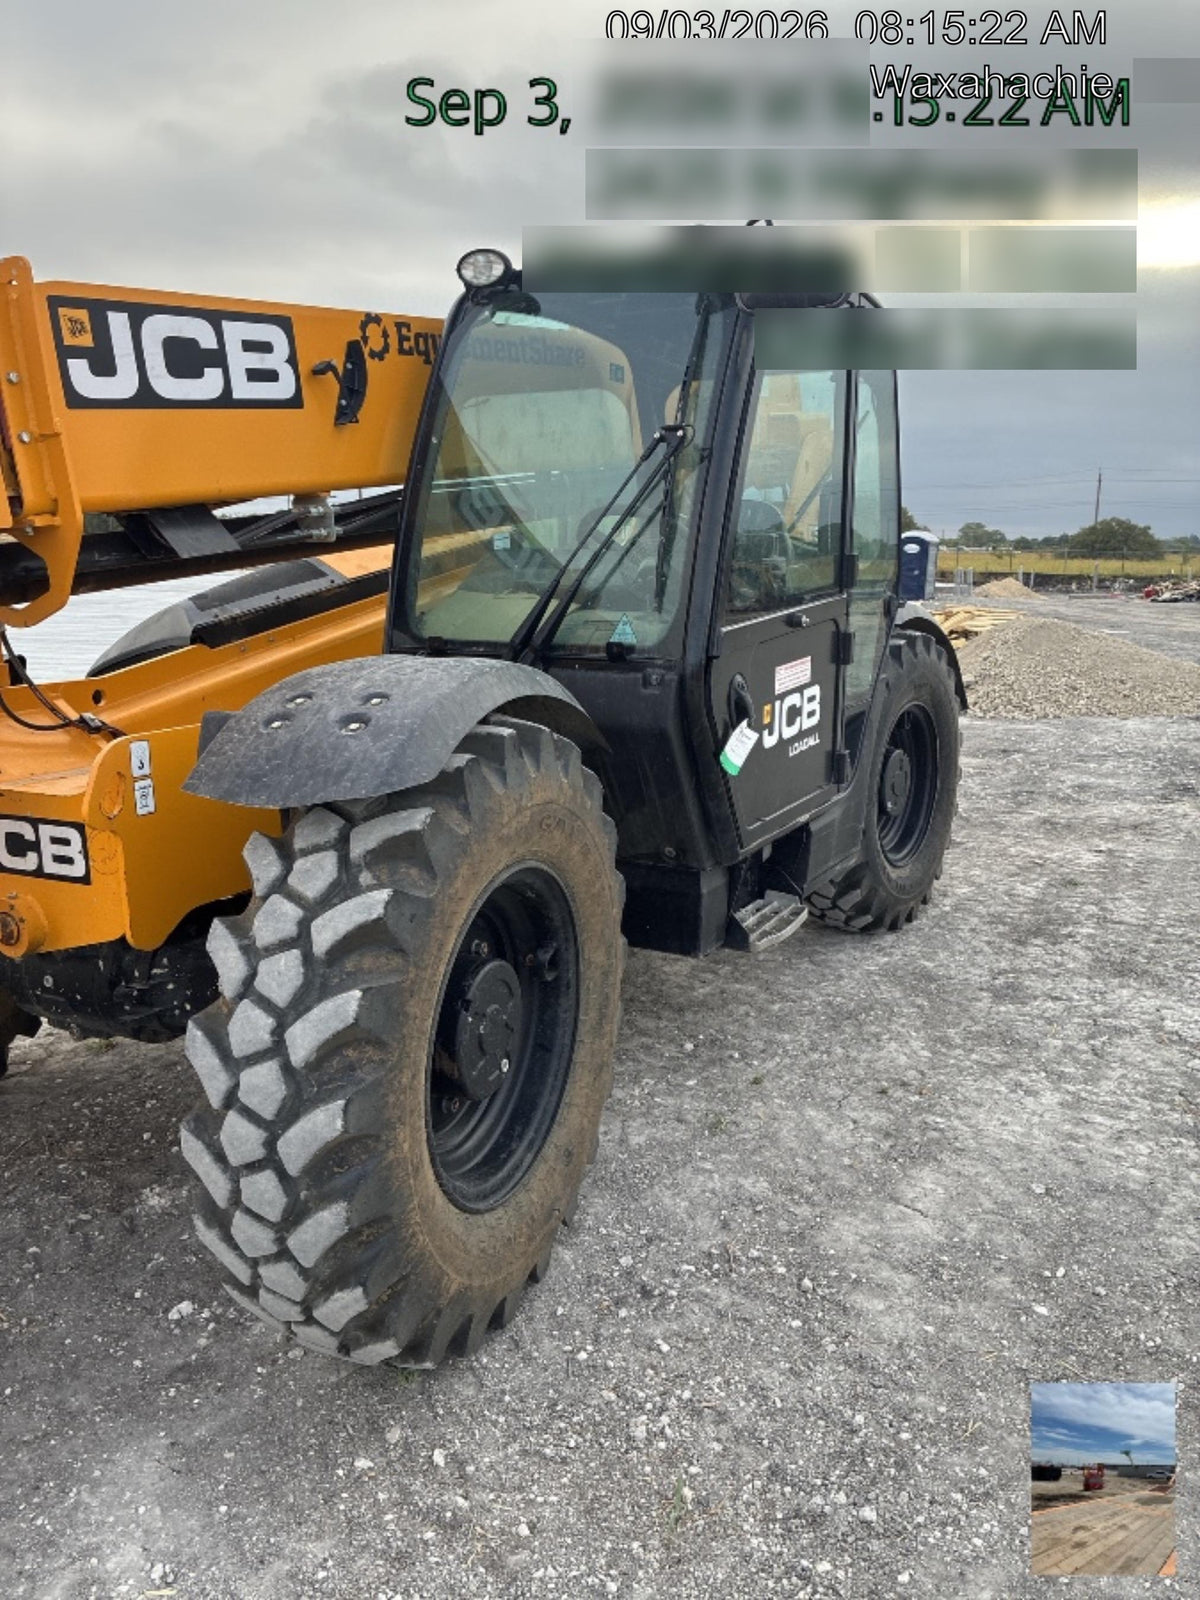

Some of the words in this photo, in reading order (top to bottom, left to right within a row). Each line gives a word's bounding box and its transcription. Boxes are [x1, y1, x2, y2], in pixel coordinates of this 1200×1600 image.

[66, 310, 297, 401] JCB
[762, 684, 821, 749] JCB
[0, 818, 87, 877] CB
